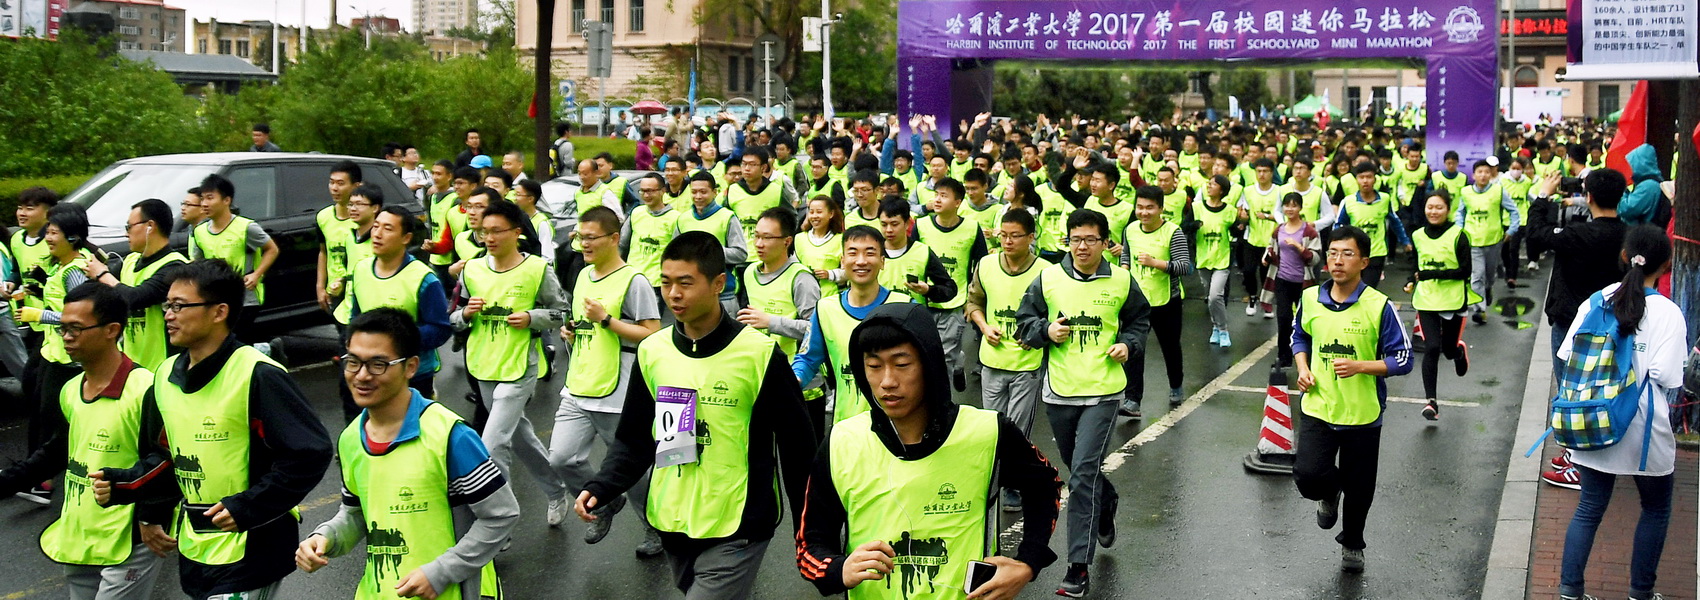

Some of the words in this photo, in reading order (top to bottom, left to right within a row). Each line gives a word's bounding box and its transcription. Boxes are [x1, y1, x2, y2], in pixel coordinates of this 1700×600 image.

[946, 39, 981, 49] HARBIN
[989, 39, 1035, 49] INSTITUTE
[1045, 39, 1058, 49] OF
[1067, 39, 1133, 50] TECHNOLOGY
[1143, 40, 1167, 50] 2017
[1178, 39, 1197, 49] THE
[1208, 39, 1236, 49] FIRST
[1247, 38, 1320, 49] SCHOOLYARD
[1331, 38, 1358, 49] MINI
[1366, 37, 1433, 48] MARATHON
